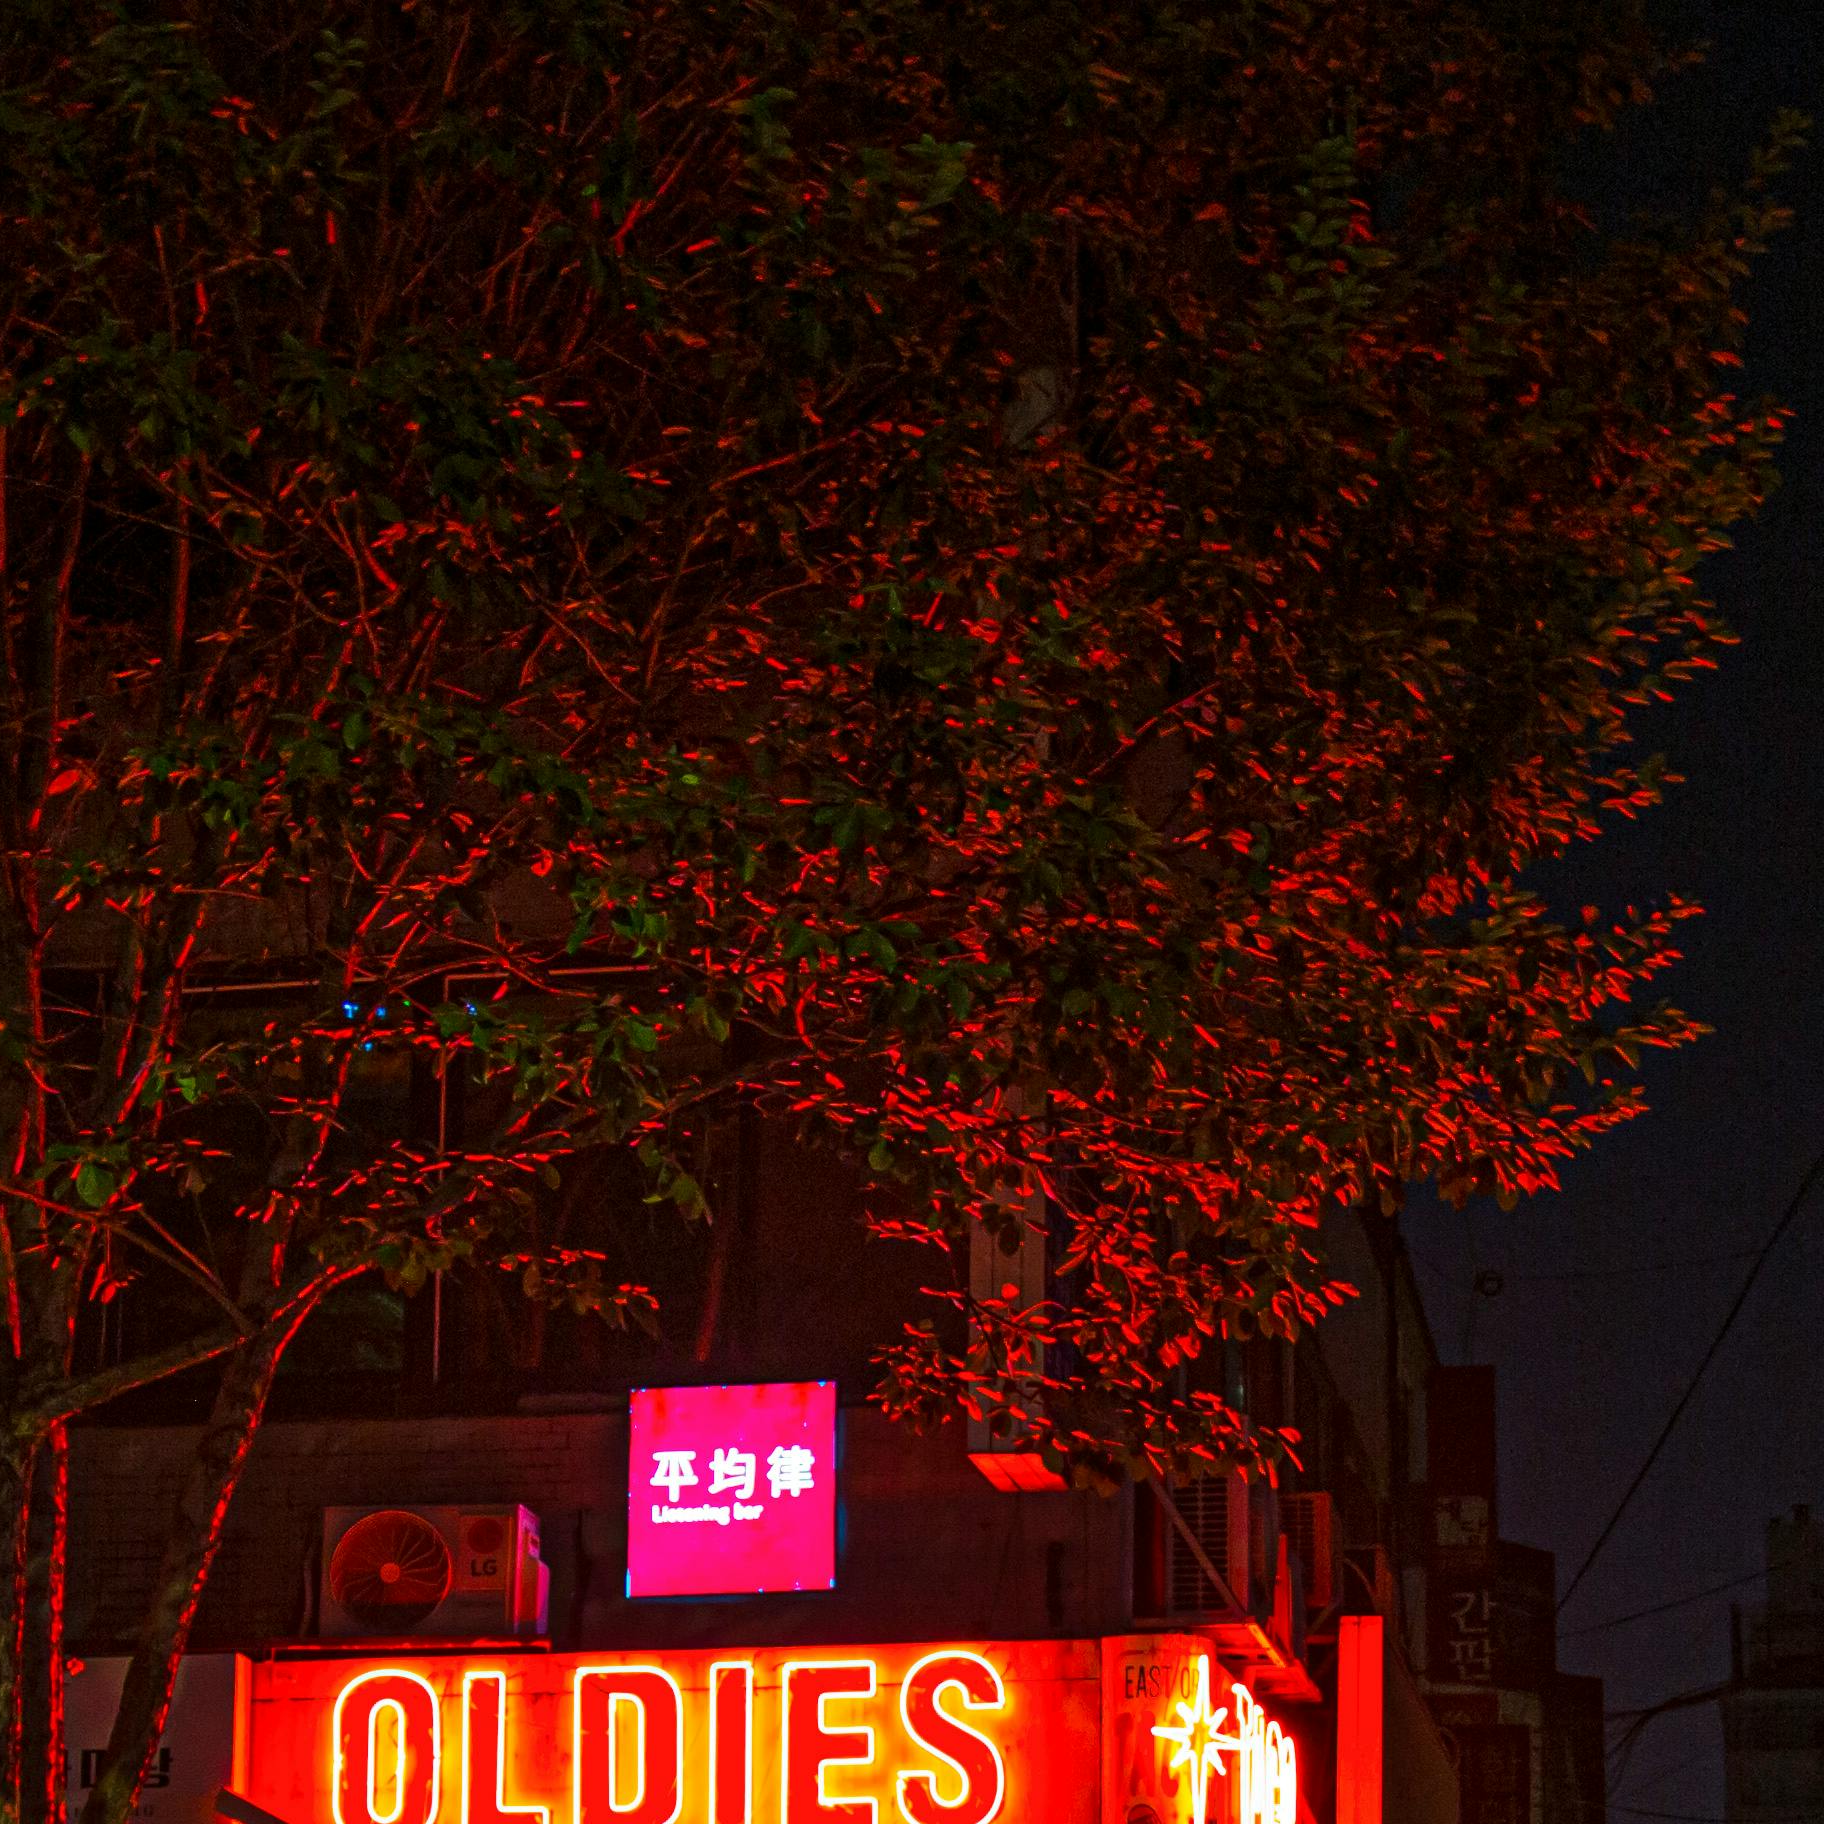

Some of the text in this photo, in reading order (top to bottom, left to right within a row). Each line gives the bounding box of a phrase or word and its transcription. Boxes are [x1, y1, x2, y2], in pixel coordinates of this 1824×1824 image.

[650, 1445, 816, 1503] 平均律
[471, 1558, 498, 1577] LG
[1450, 1588, 1495, 1682] 간판
[1124, 1665, 1174, 1700] EAST
